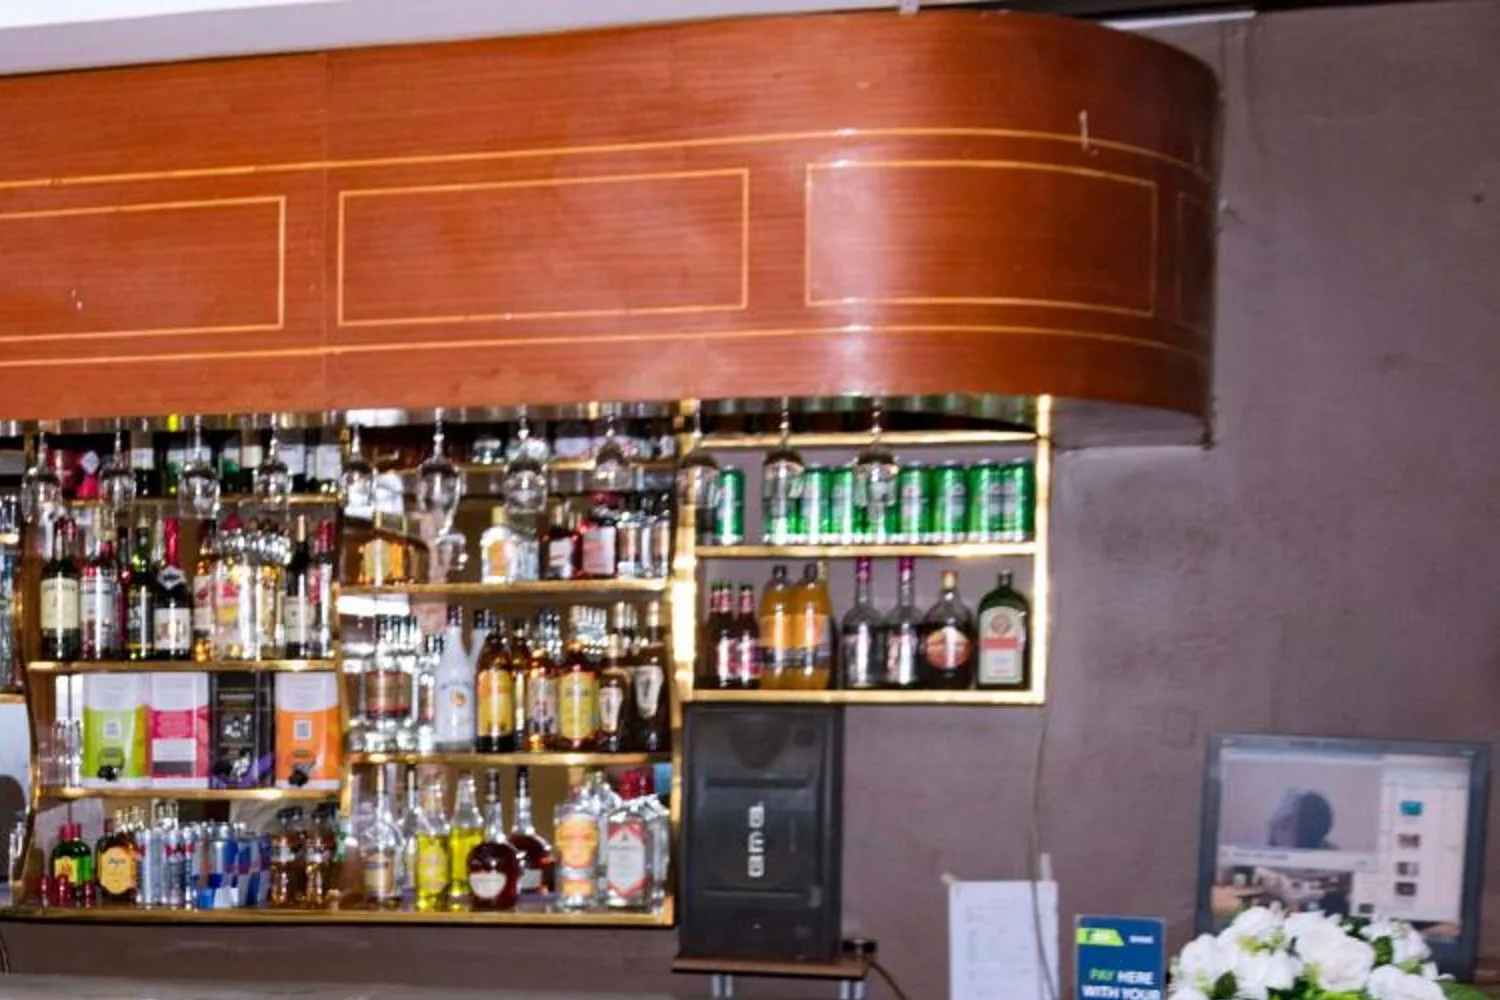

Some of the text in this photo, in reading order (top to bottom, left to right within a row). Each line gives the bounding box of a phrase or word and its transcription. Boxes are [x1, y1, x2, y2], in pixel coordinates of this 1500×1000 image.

[1089, 968, 1155, 985] PAY HERE
[1081, 985, 1120, 999] WITH
